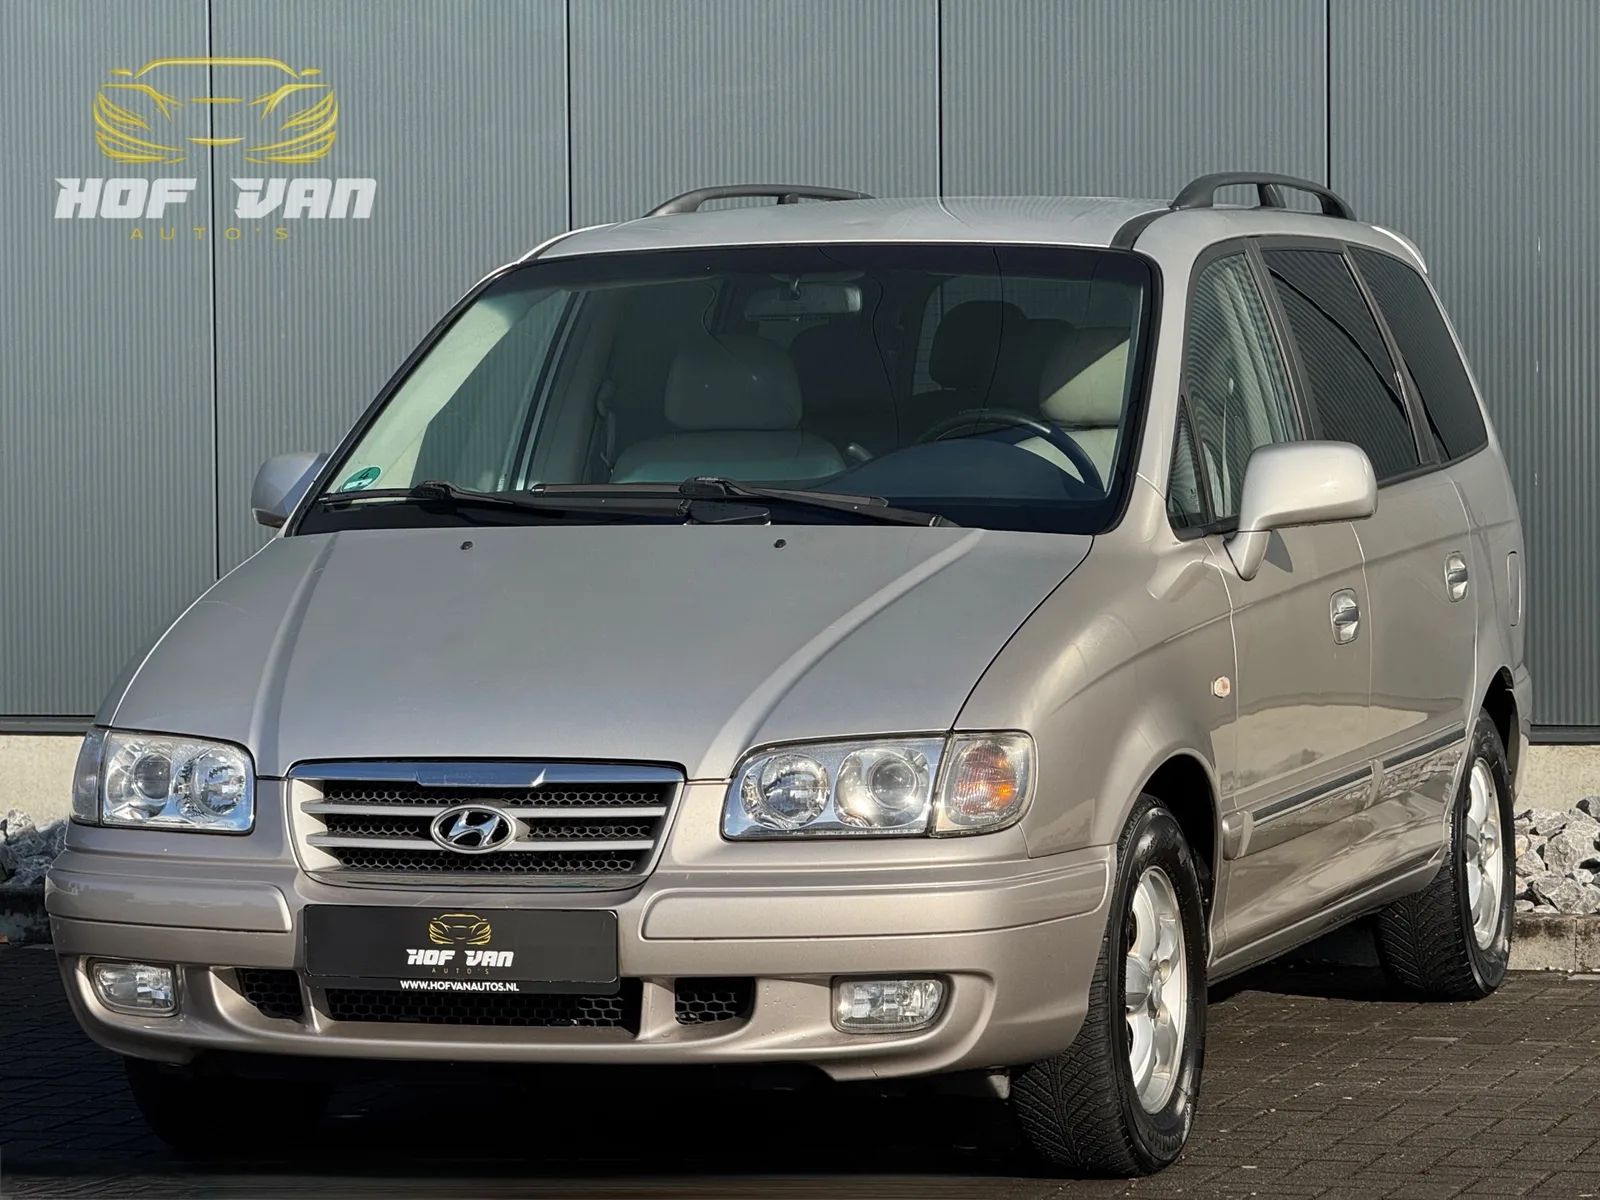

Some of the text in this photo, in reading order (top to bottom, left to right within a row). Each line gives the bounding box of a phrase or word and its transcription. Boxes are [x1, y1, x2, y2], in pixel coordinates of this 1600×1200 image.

[406, 949, 514, 967] HOF VAN
[431, 967, 489, 975] AUTO'S
[400, 980, 520, 992] WWW.HOFVANAUTOS.NL
